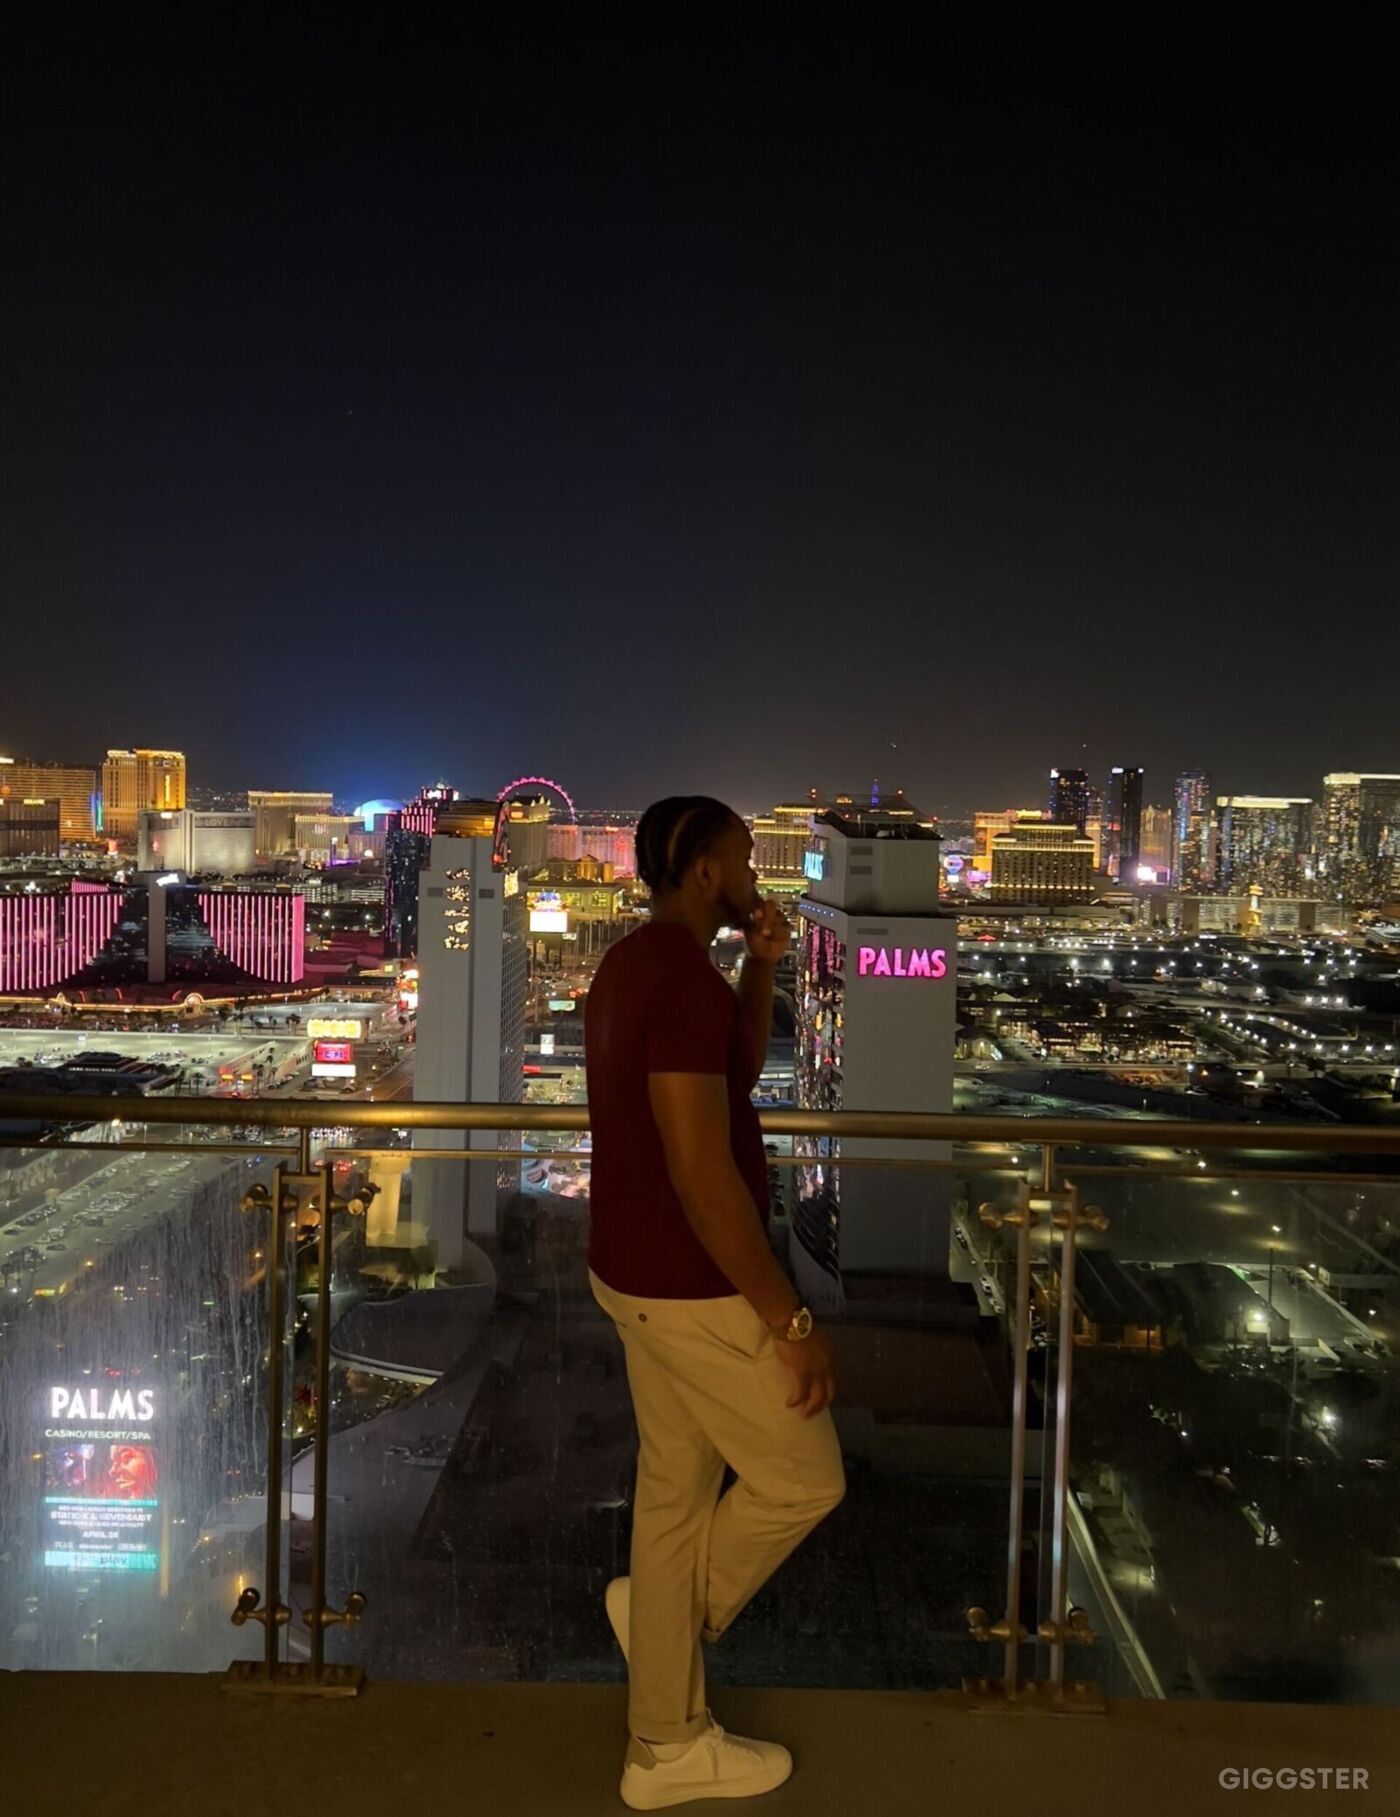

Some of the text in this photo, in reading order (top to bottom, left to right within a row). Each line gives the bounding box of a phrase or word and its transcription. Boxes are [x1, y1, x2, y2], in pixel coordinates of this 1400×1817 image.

[859, 946, 947, 978] PALMS
[51, 1387, 154, 1421] PALMS
[45, 1428, 152, 1440] CASINO/RESORT/SPA
